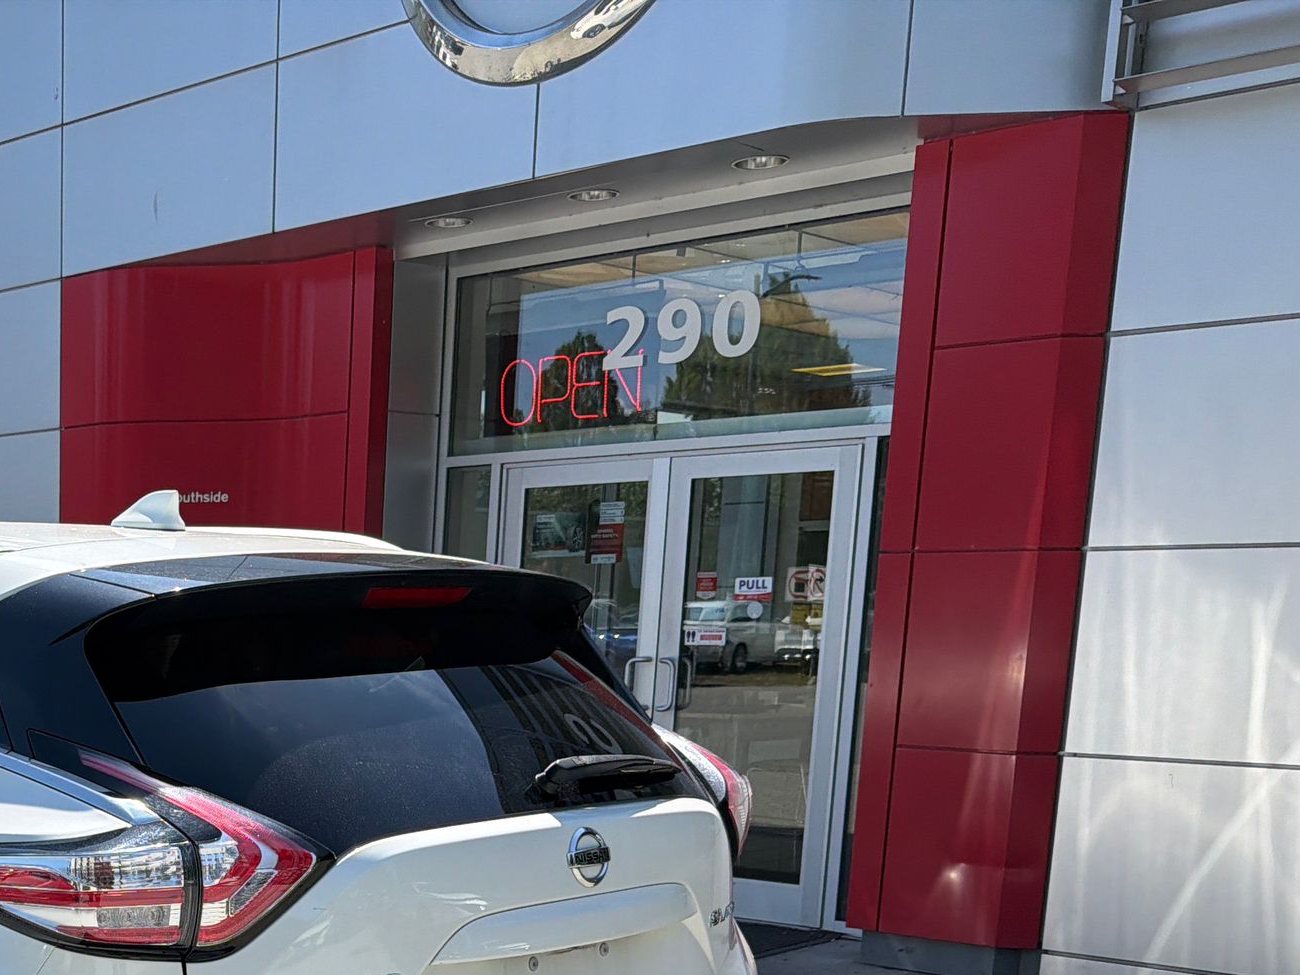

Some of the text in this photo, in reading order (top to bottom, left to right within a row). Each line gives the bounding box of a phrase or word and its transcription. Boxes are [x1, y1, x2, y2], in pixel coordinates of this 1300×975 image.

[602, 290, 761, 371] 290
[500, 349, 644, 427] OPEN
[738, 579, 768, 590] PULL
[574, 848, 610, 866] NISSAN
